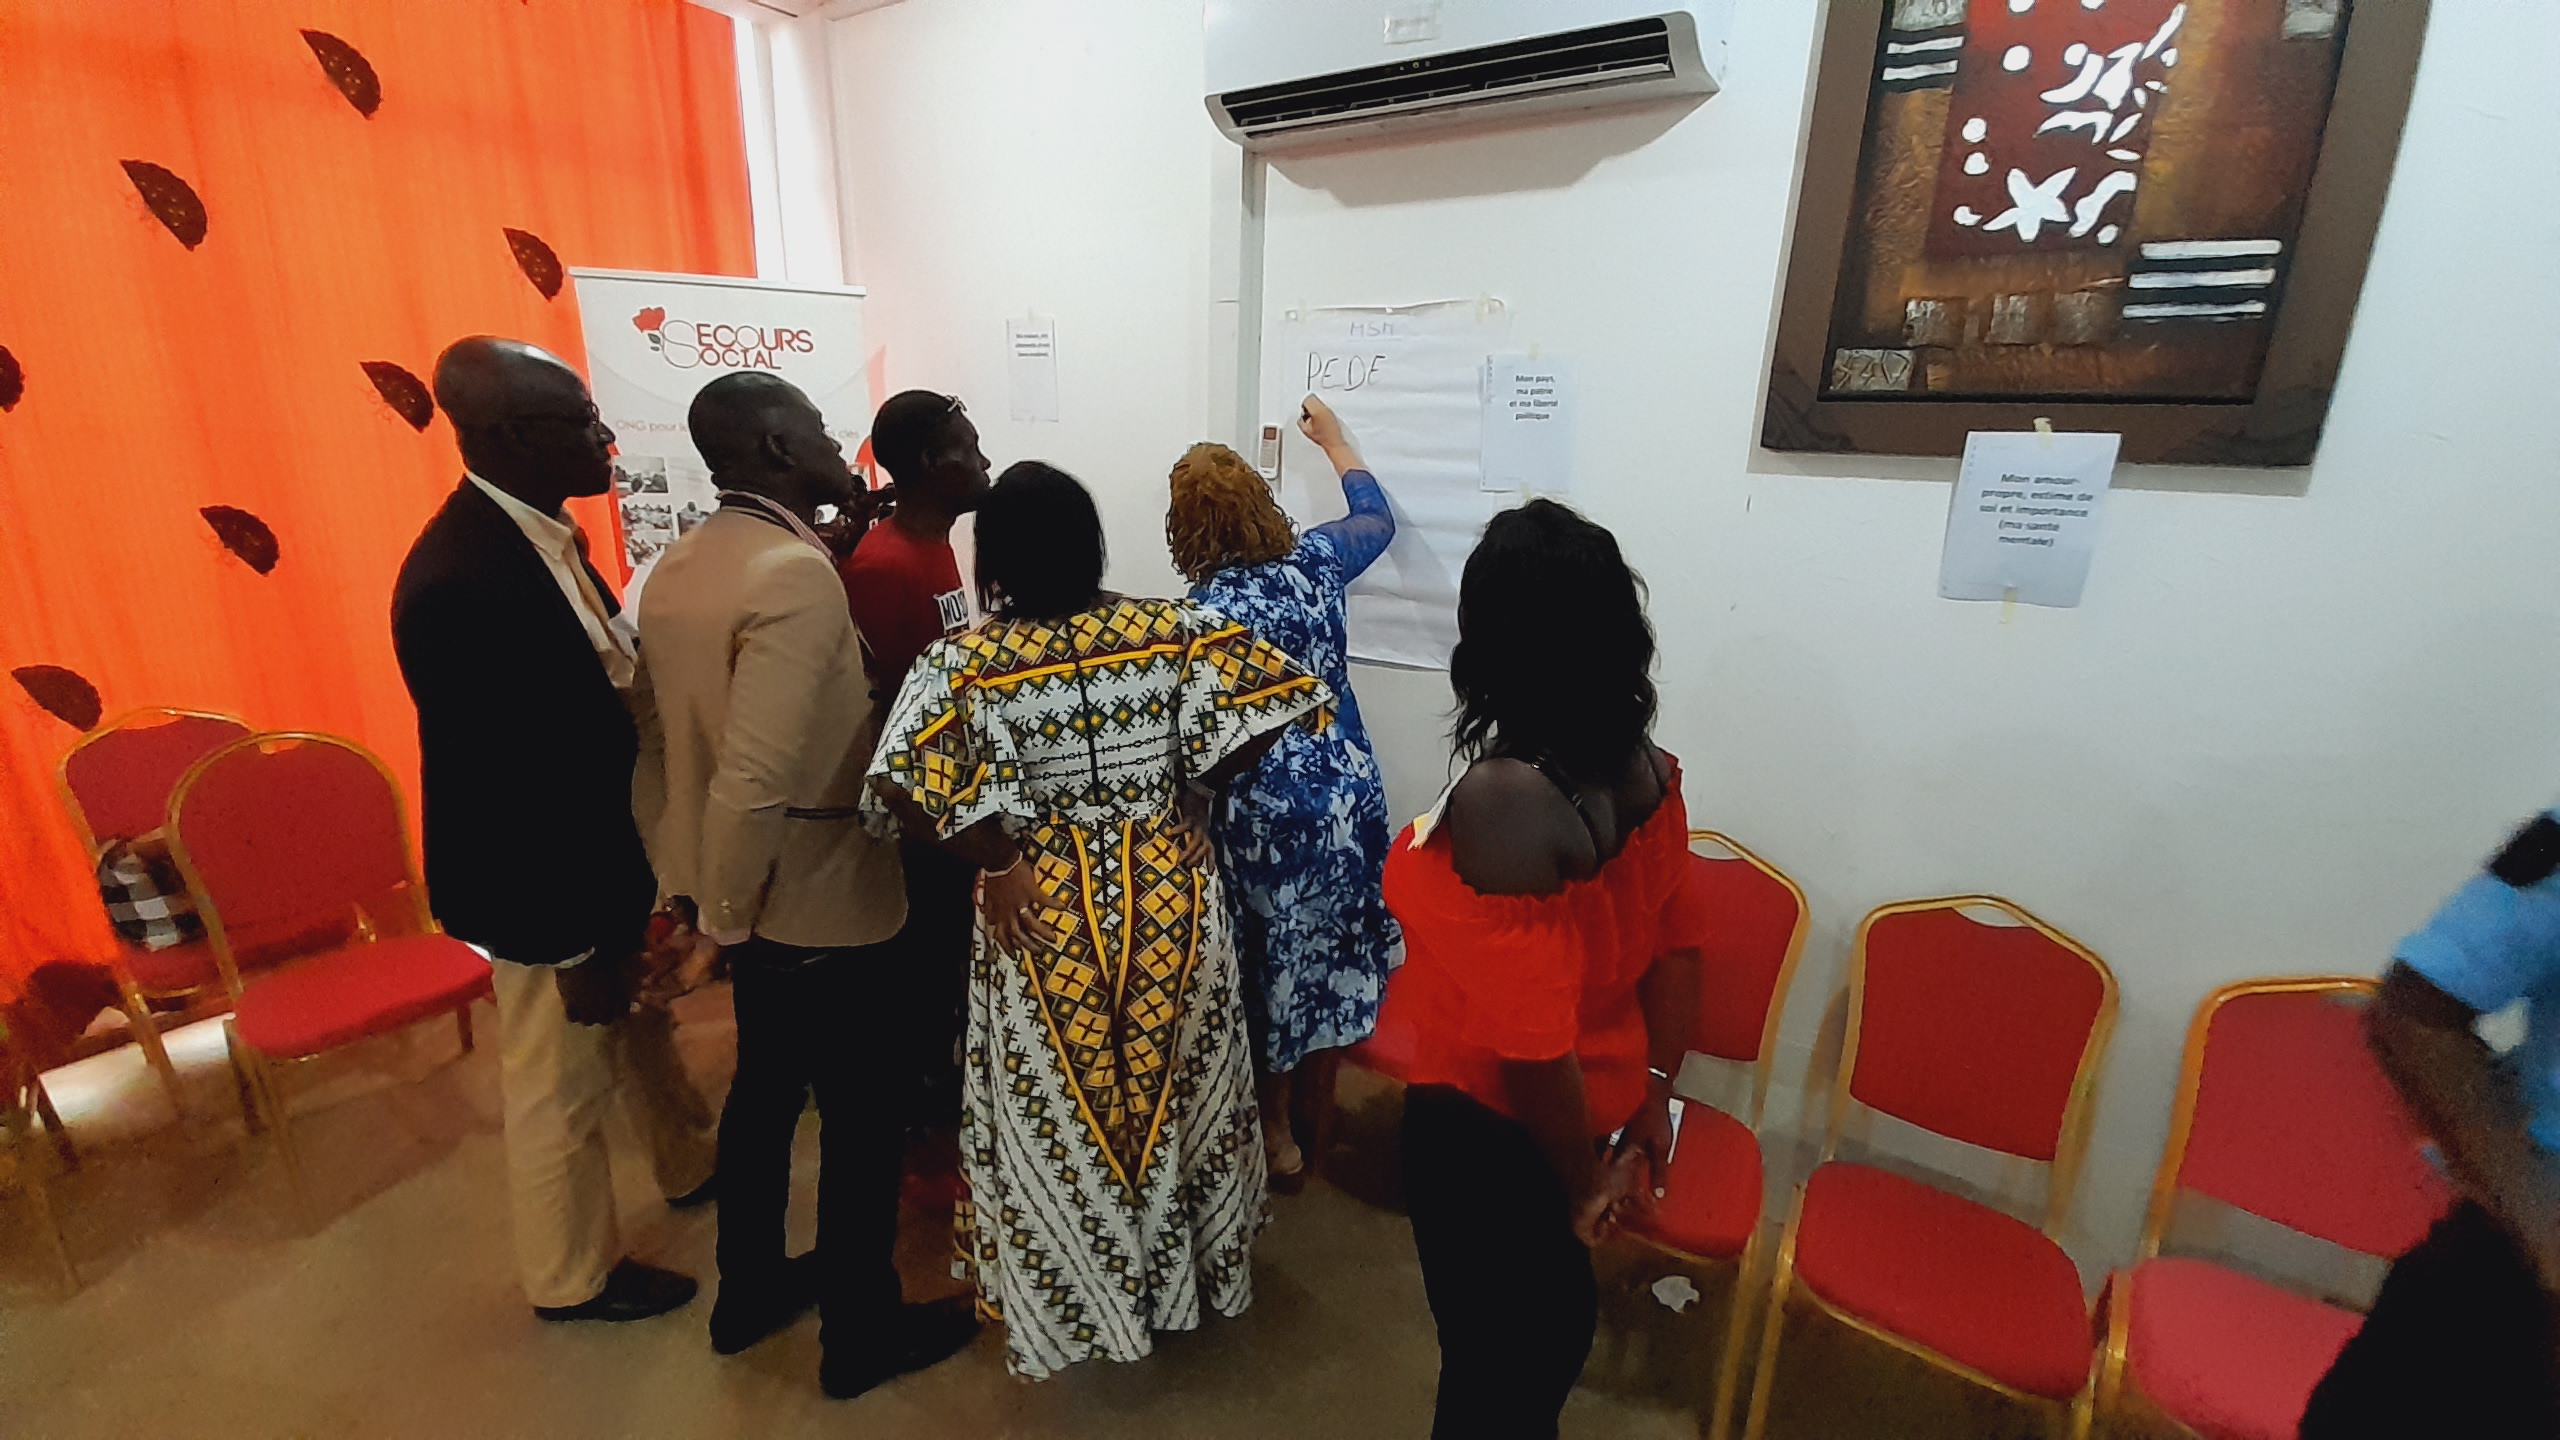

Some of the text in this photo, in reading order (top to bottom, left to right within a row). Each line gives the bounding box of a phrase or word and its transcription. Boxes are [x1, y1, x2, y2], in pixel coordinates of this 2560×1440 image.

[662, 320, 814, 358] SECOURS
[1306, 351, 1387, 391] PEDE
[615, 420, 647, 431] ONG
[649, 422, 676, 432] pour
[2001, 473, 2029, 483] Mon
[2031, 491, 2073, 500] estime
[2077, 493, 2094, 501] de
[1979, 504, 2088, 517] soi et importance
[1999, 519, 2022, 530] (ma
[1999, 536, 2055, 547] mentale)
